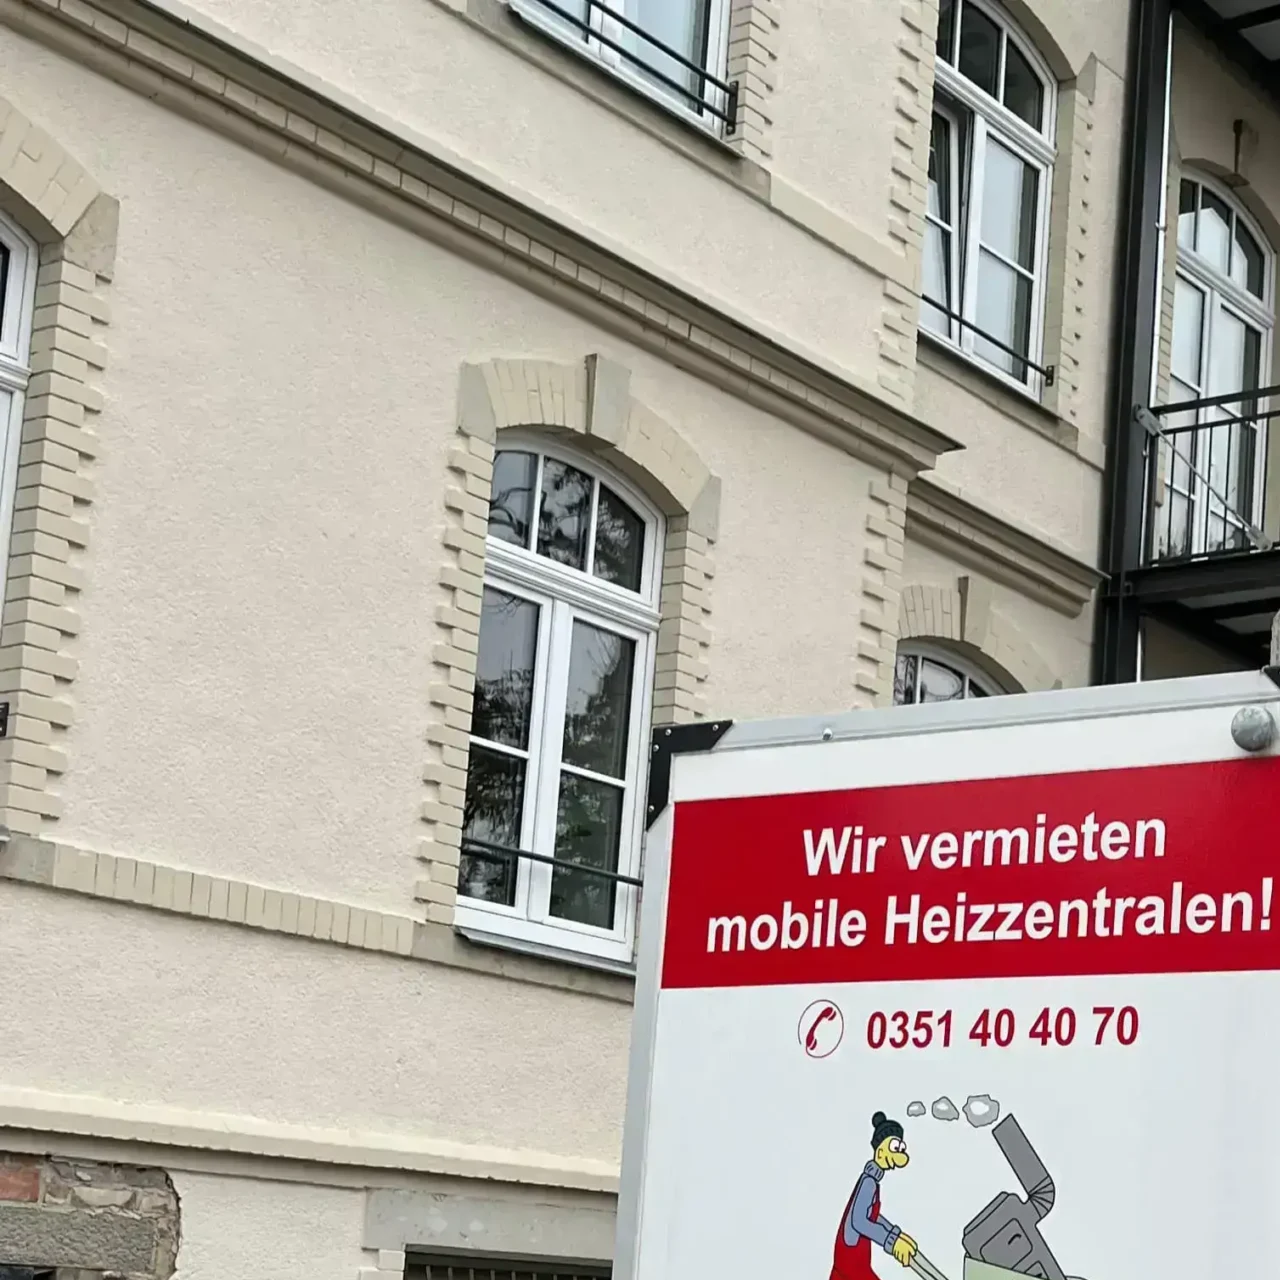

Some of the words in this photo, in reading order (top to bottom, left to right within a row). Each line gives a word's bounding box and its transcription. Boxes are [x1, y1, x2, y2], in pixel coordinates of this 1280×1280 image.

[803, 826, 887, 876] Wir
[900, 811, 1166, 871] vermieten
[706, 898, 867, 953] mobile
[884, 877, 1274, 945] Heizzentralen!
[866, 1009, 953, 1050] 0351
[968, 1007, 1016, 1049] 40
[1028, 1006, 1077, 1047] 40
[1092, 1005, 1140, 1046] 70
